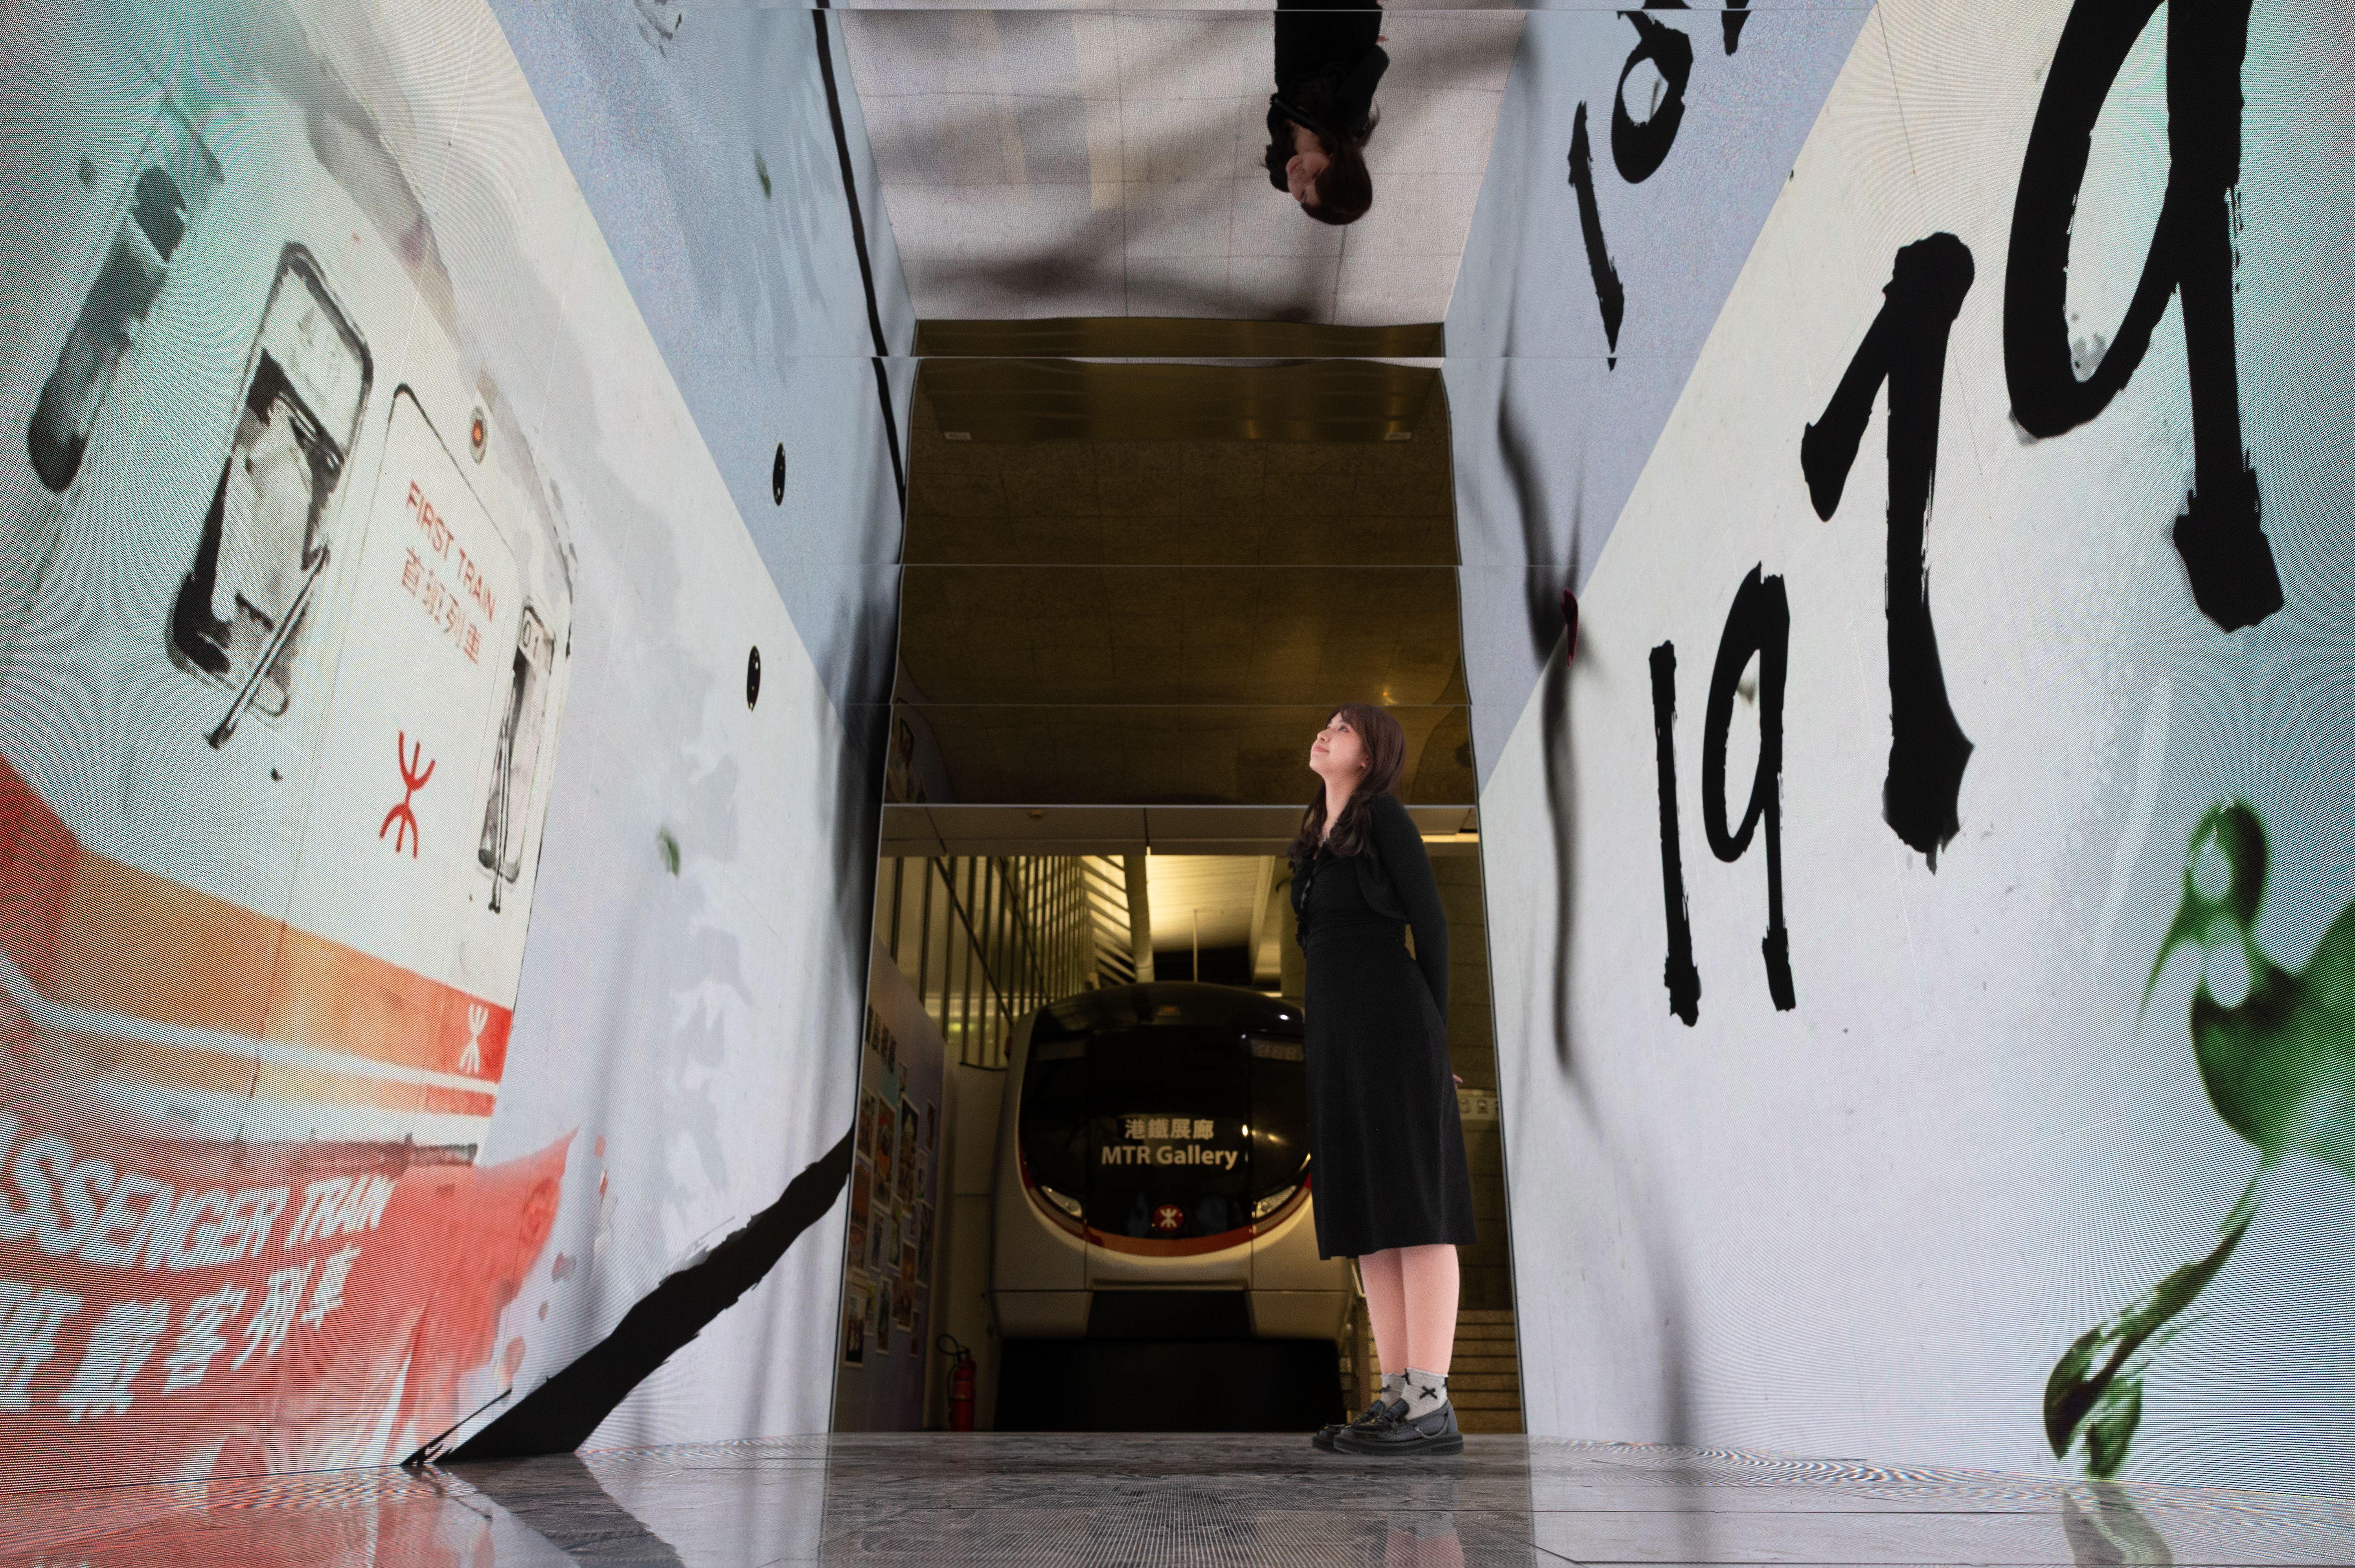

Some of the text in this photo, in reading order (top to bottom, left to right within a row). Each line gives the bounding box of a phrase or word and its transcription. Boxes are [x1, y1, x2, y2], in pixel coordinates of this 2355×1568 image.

[407, 480, 496, 622] FIRST TRAIN
[1649, 0, 2285, 1028] 1979
[0, 1110, 398, 1271] SSENGER TRAIN
[1101, 1144, 1239, 1170] MTR Gallery
[1125, 1118, 1214, 1140] 港鐵展廊
